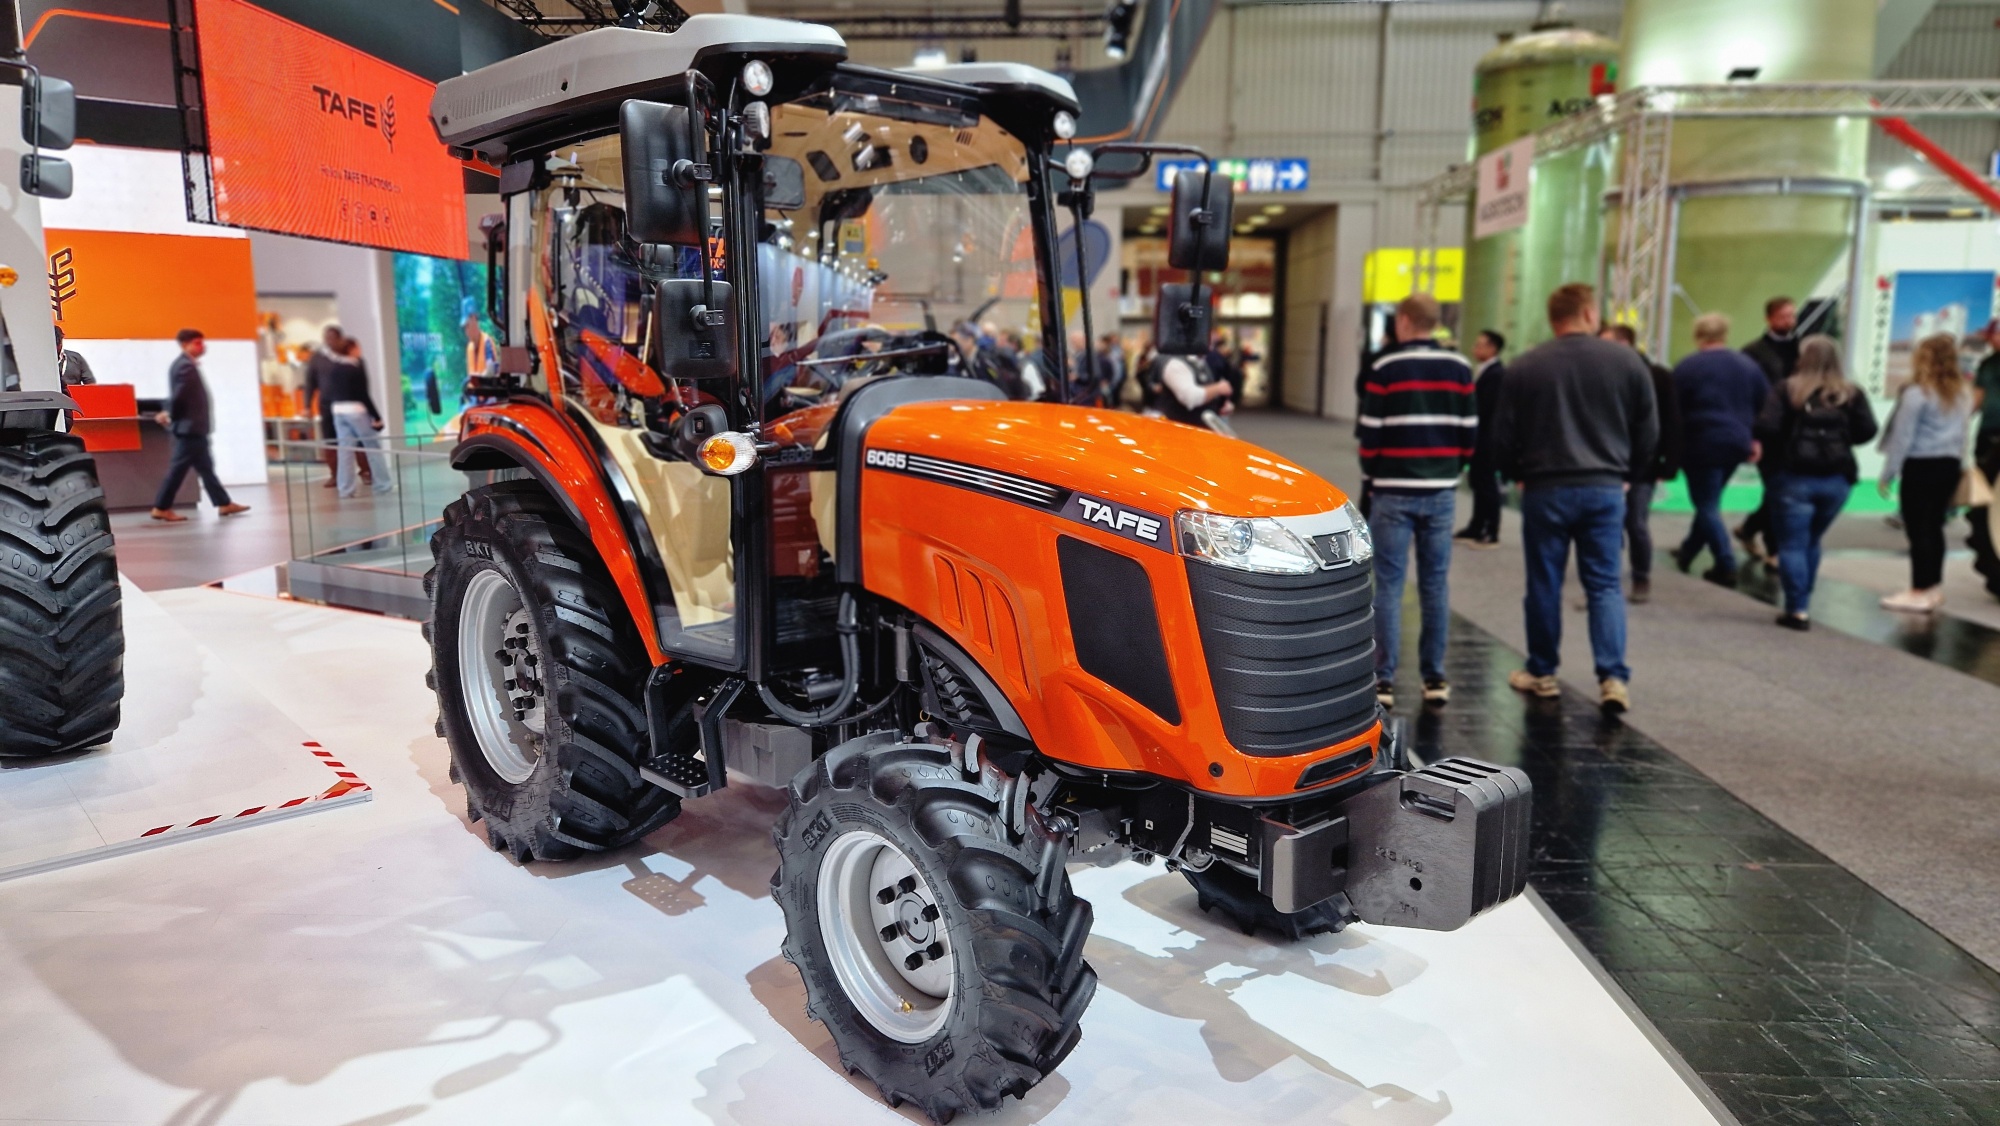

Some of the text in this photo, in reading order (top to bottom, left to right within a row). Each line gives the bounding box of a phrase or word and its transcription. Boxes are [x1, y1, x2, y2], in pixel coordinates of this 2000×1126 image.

[312, 84, 377, 128] TAFE
[866, 448, 907, 469] 6065
[1078, 497, 1161, 541] TAFE
[464, 539, 492, 557] BKT
[802, 810, 832, 850] BKT
[1375, 846, 1397, 862] 25
[925, 1036, 955, 1076] BKT
